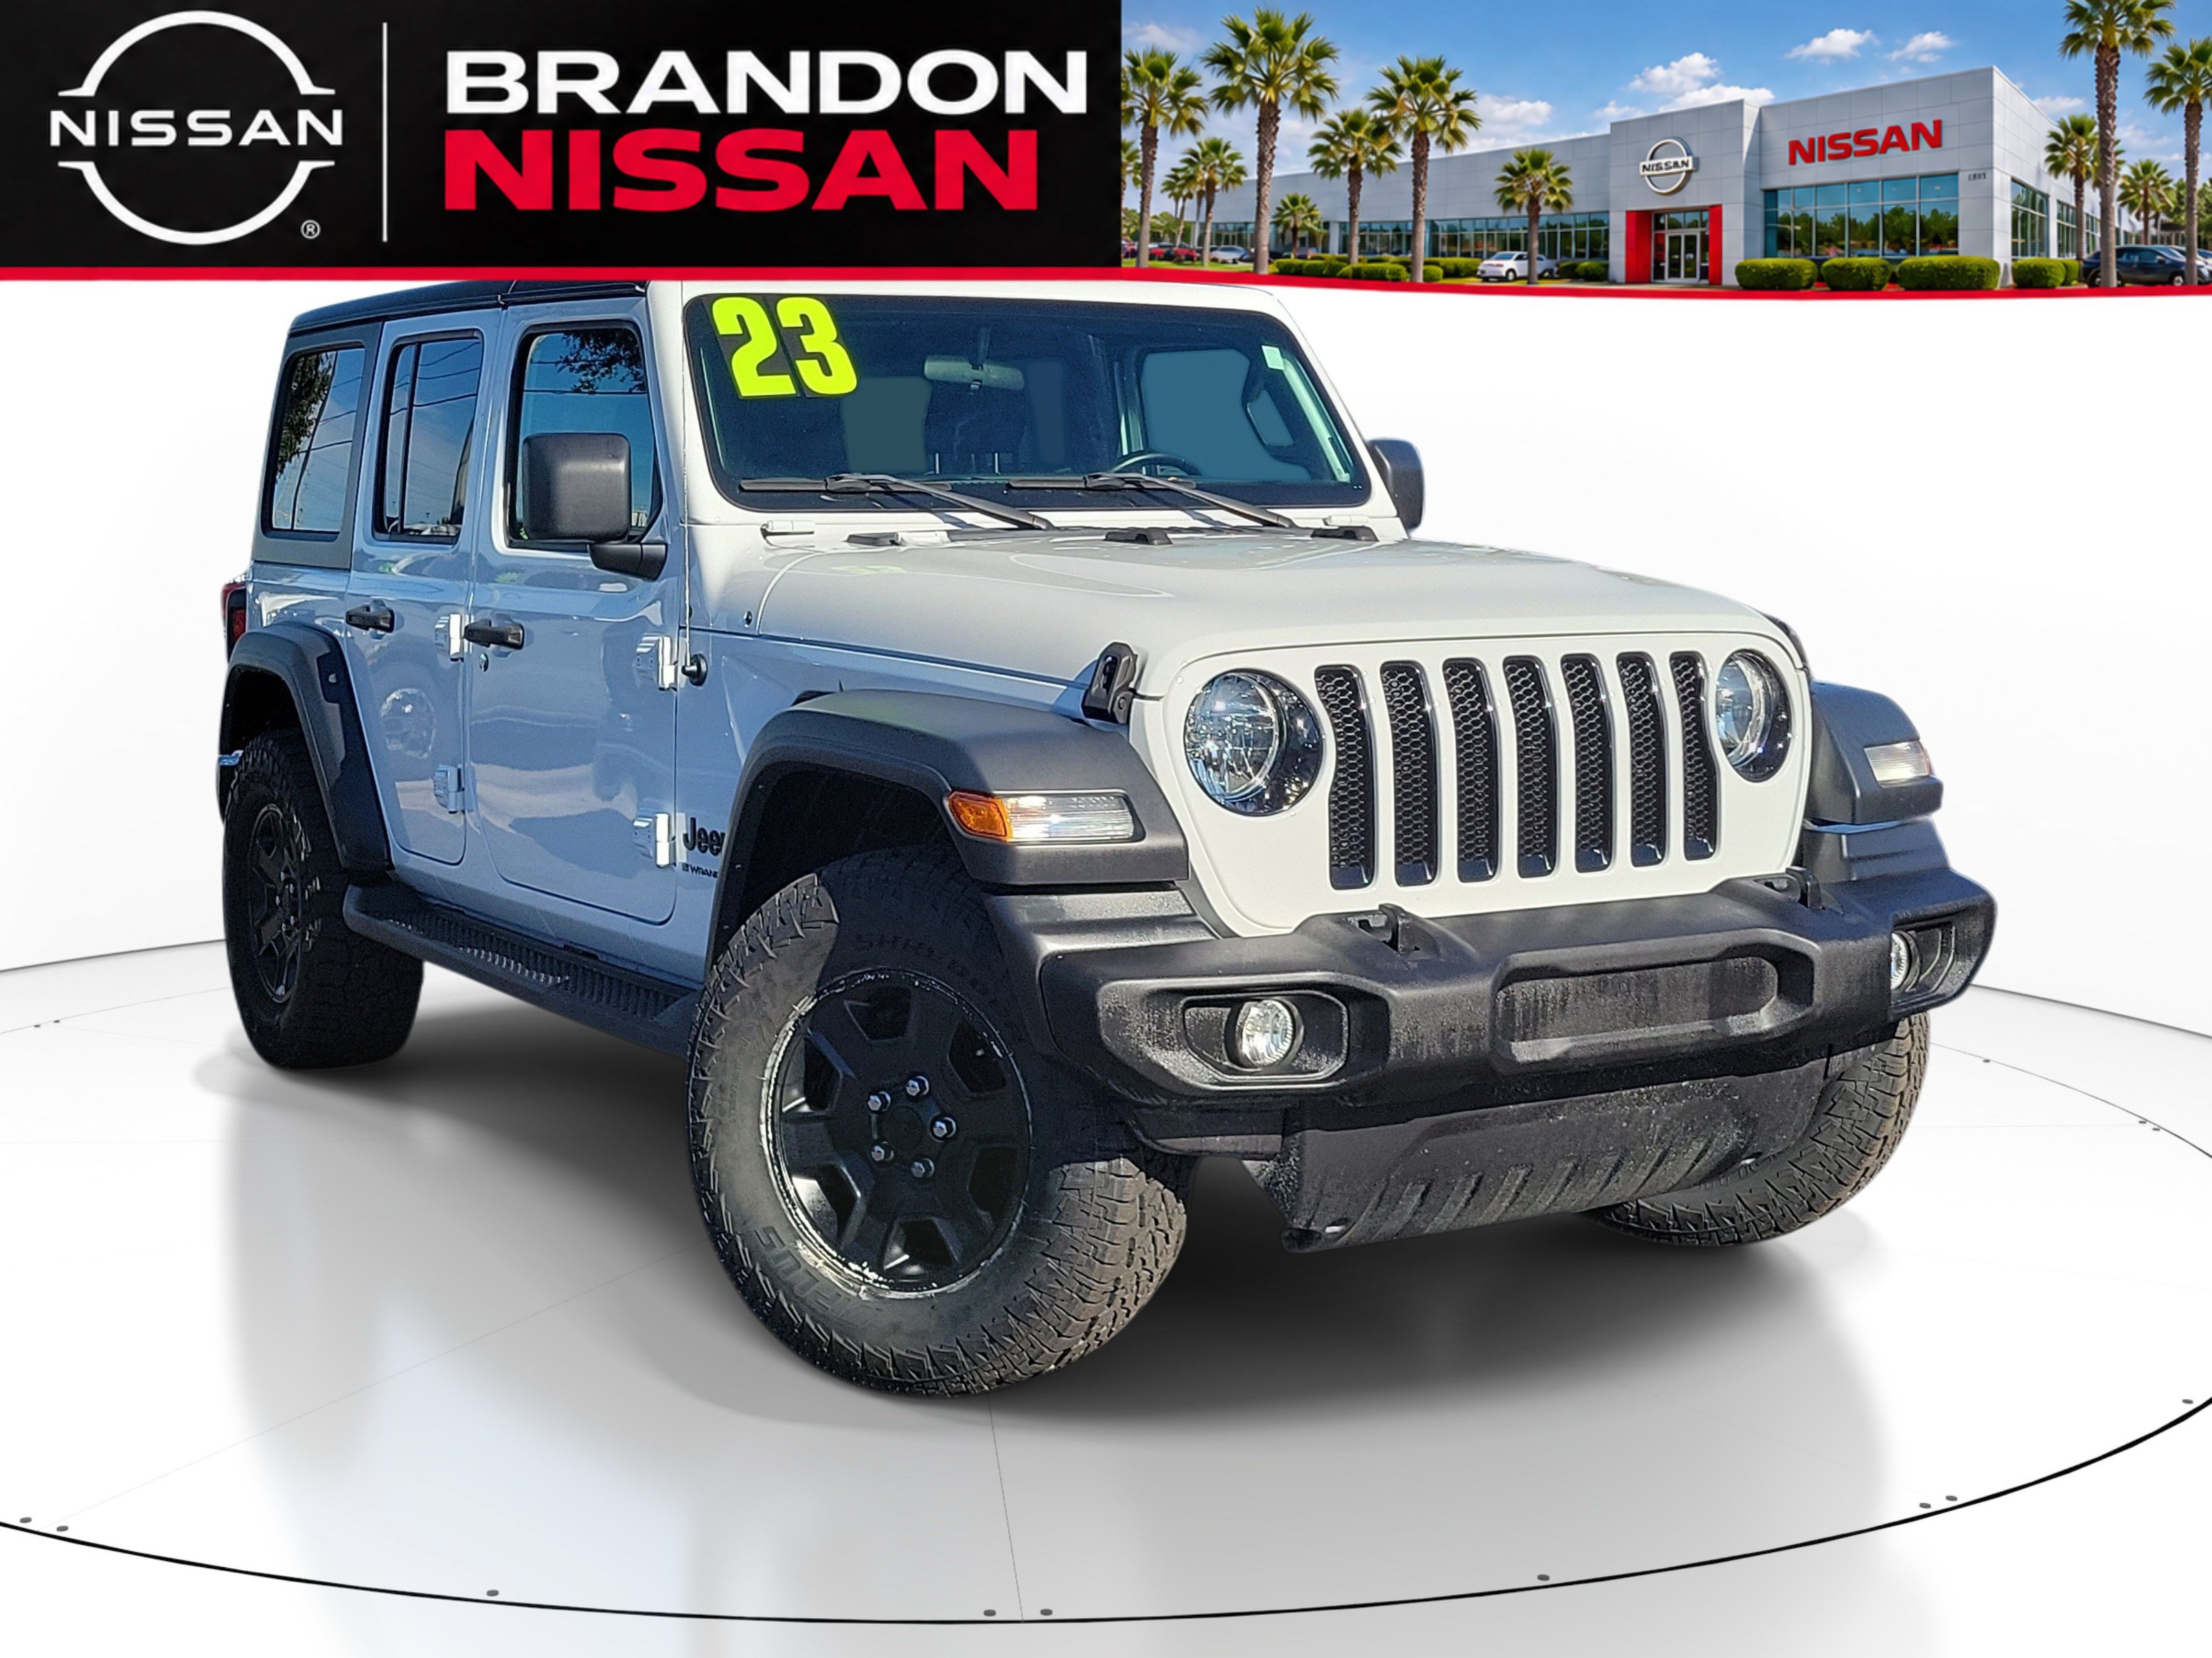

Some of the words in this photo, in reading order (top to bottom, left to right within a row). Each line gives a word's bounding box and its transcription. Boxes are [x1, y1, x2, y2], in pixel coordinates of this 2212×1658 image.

[1788, 119, 1941, 165] NISSAN
[1641, 159, 1689, 173] NISSAN
[711, 296, 858, 397] 23
